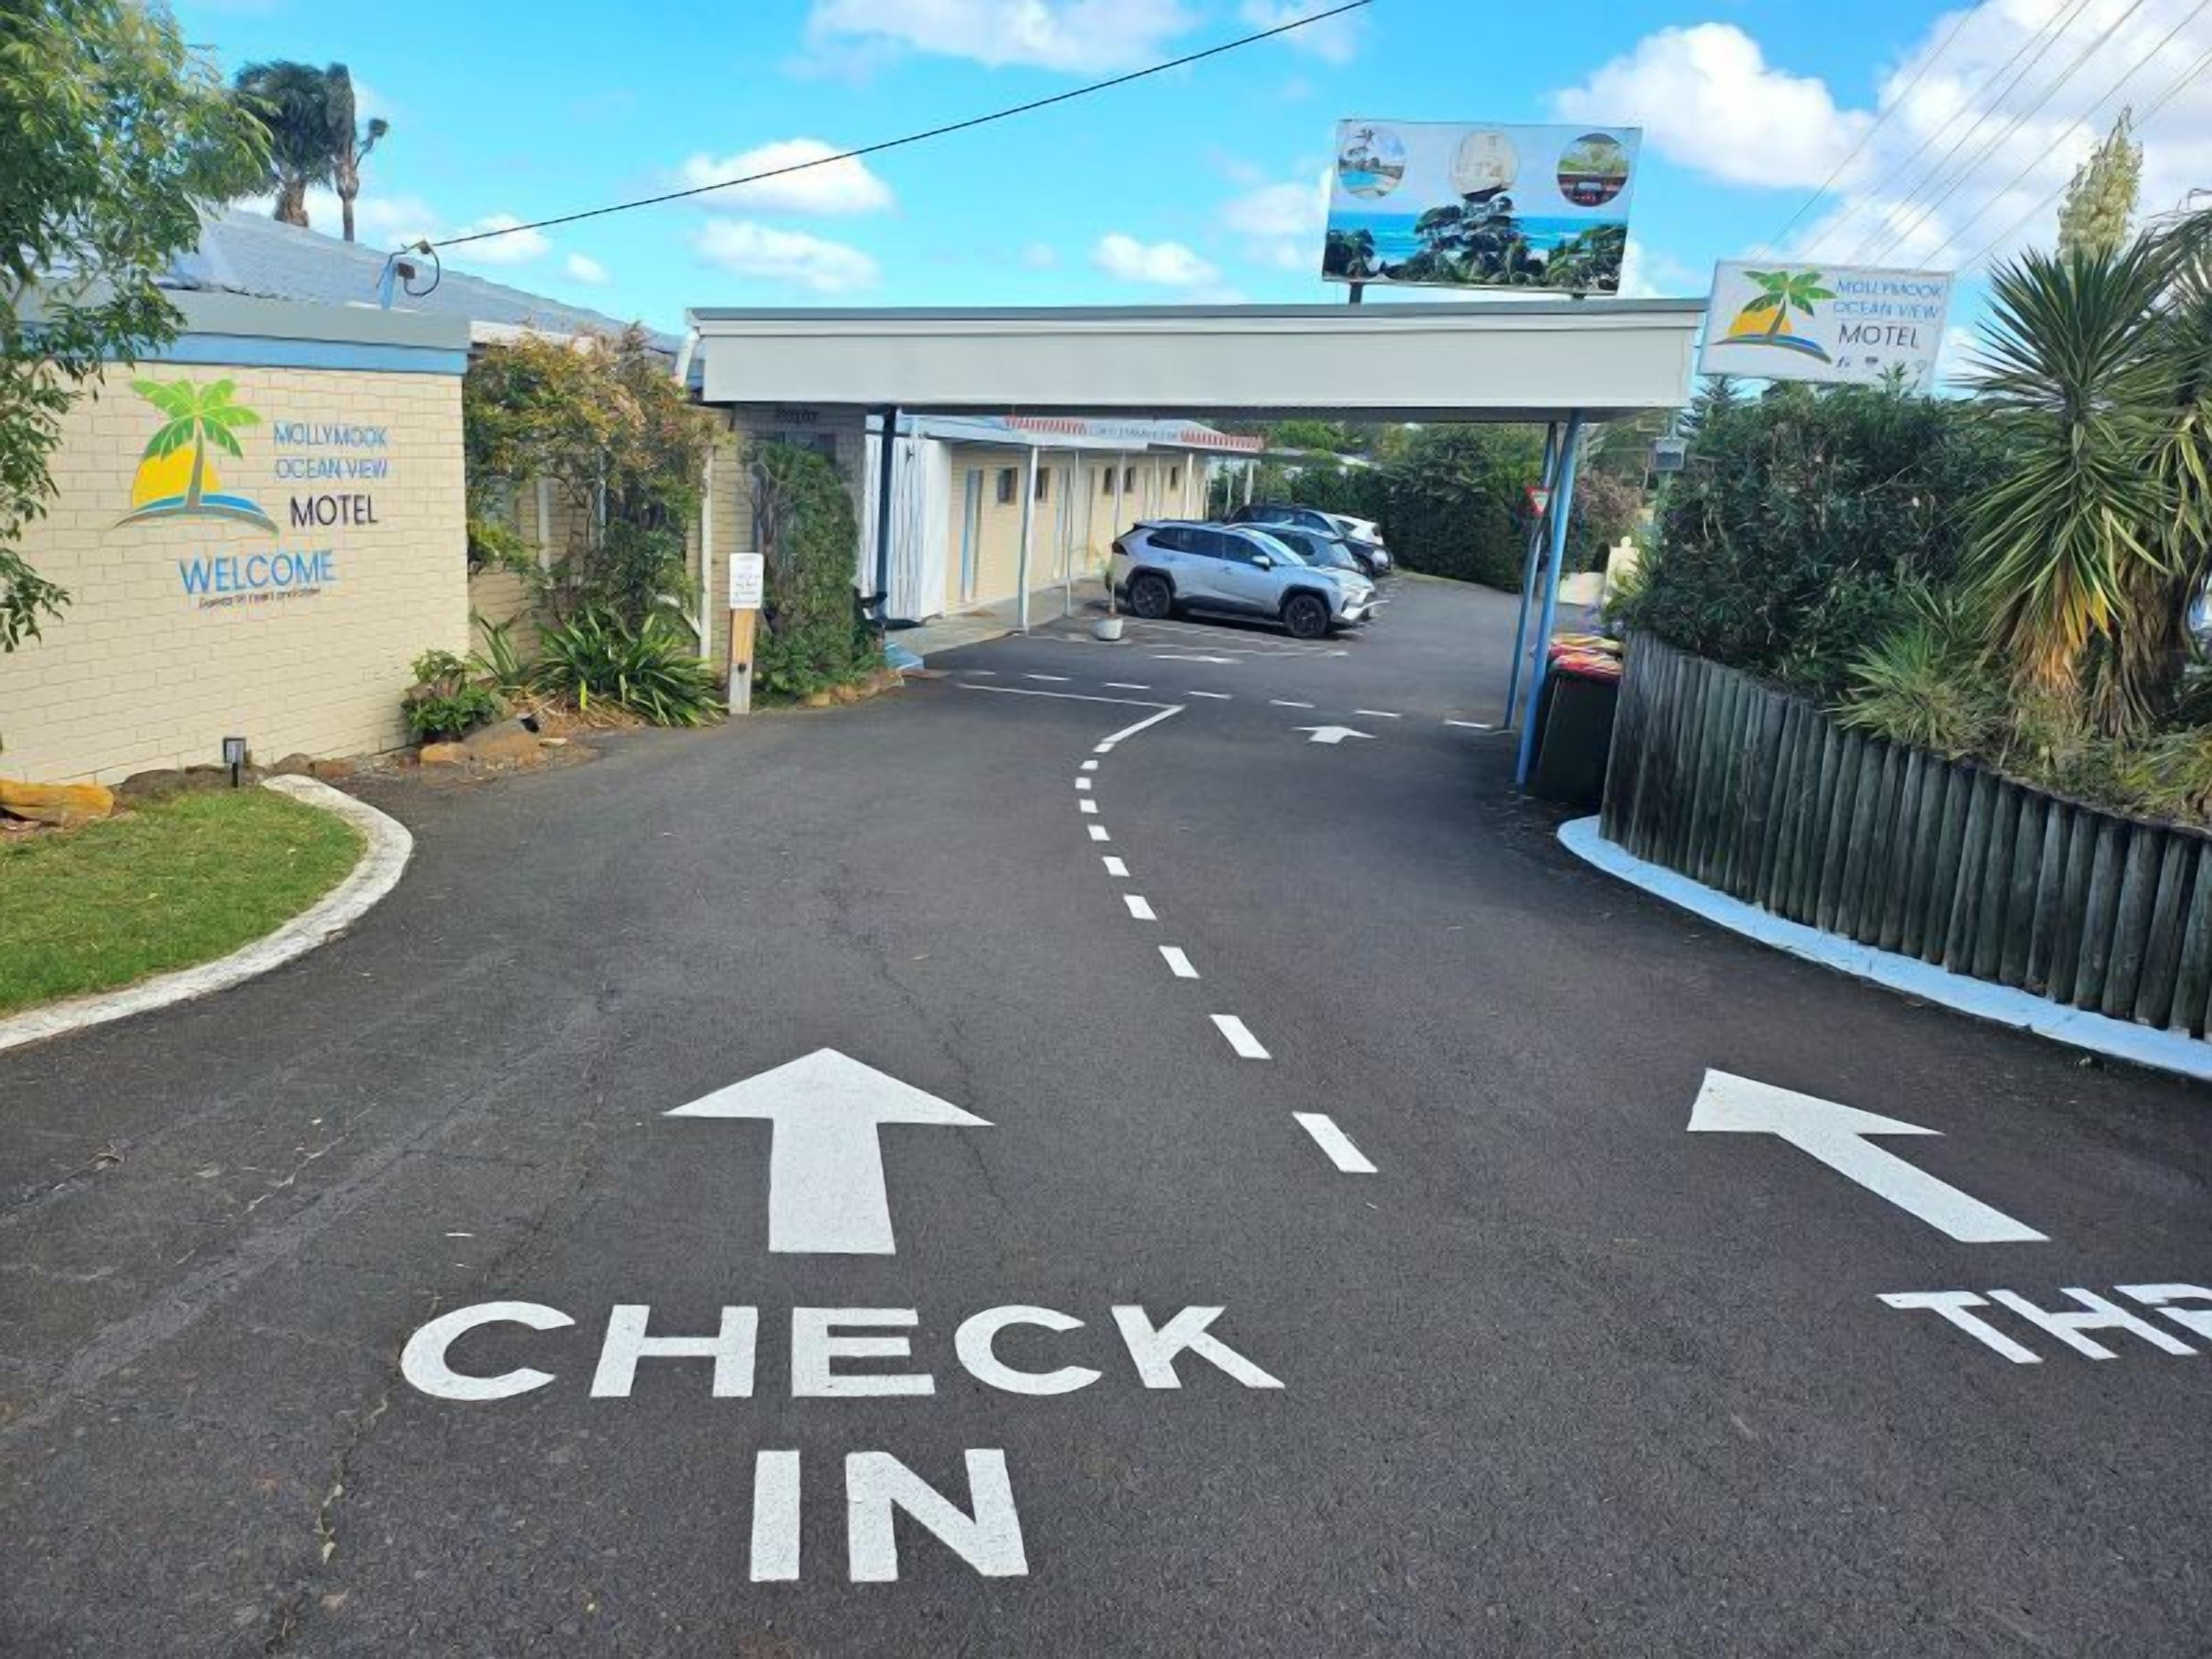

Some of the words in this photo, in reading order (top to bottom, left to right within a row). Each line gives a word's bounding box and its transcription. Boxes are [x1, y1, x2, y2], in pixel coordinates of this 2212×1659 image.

[1834, 301, 1891, 316] OCEAN
[1899, 304, 1938, 319] VIEW
[1839, 324, 1920, 348] MOTEL
[274, 423, 387, 447] MOLLYMOOK
[276, 458, 341, 479] OCEAN
[346, 459, 387, 478] VIEW
[290, 493, 378, 527] MOTEL
[179, 550, 336, 594] WELCOME
[401, 1301, 1285, 1400] CHECK
[750, 1449, 1029, 1582] IN
